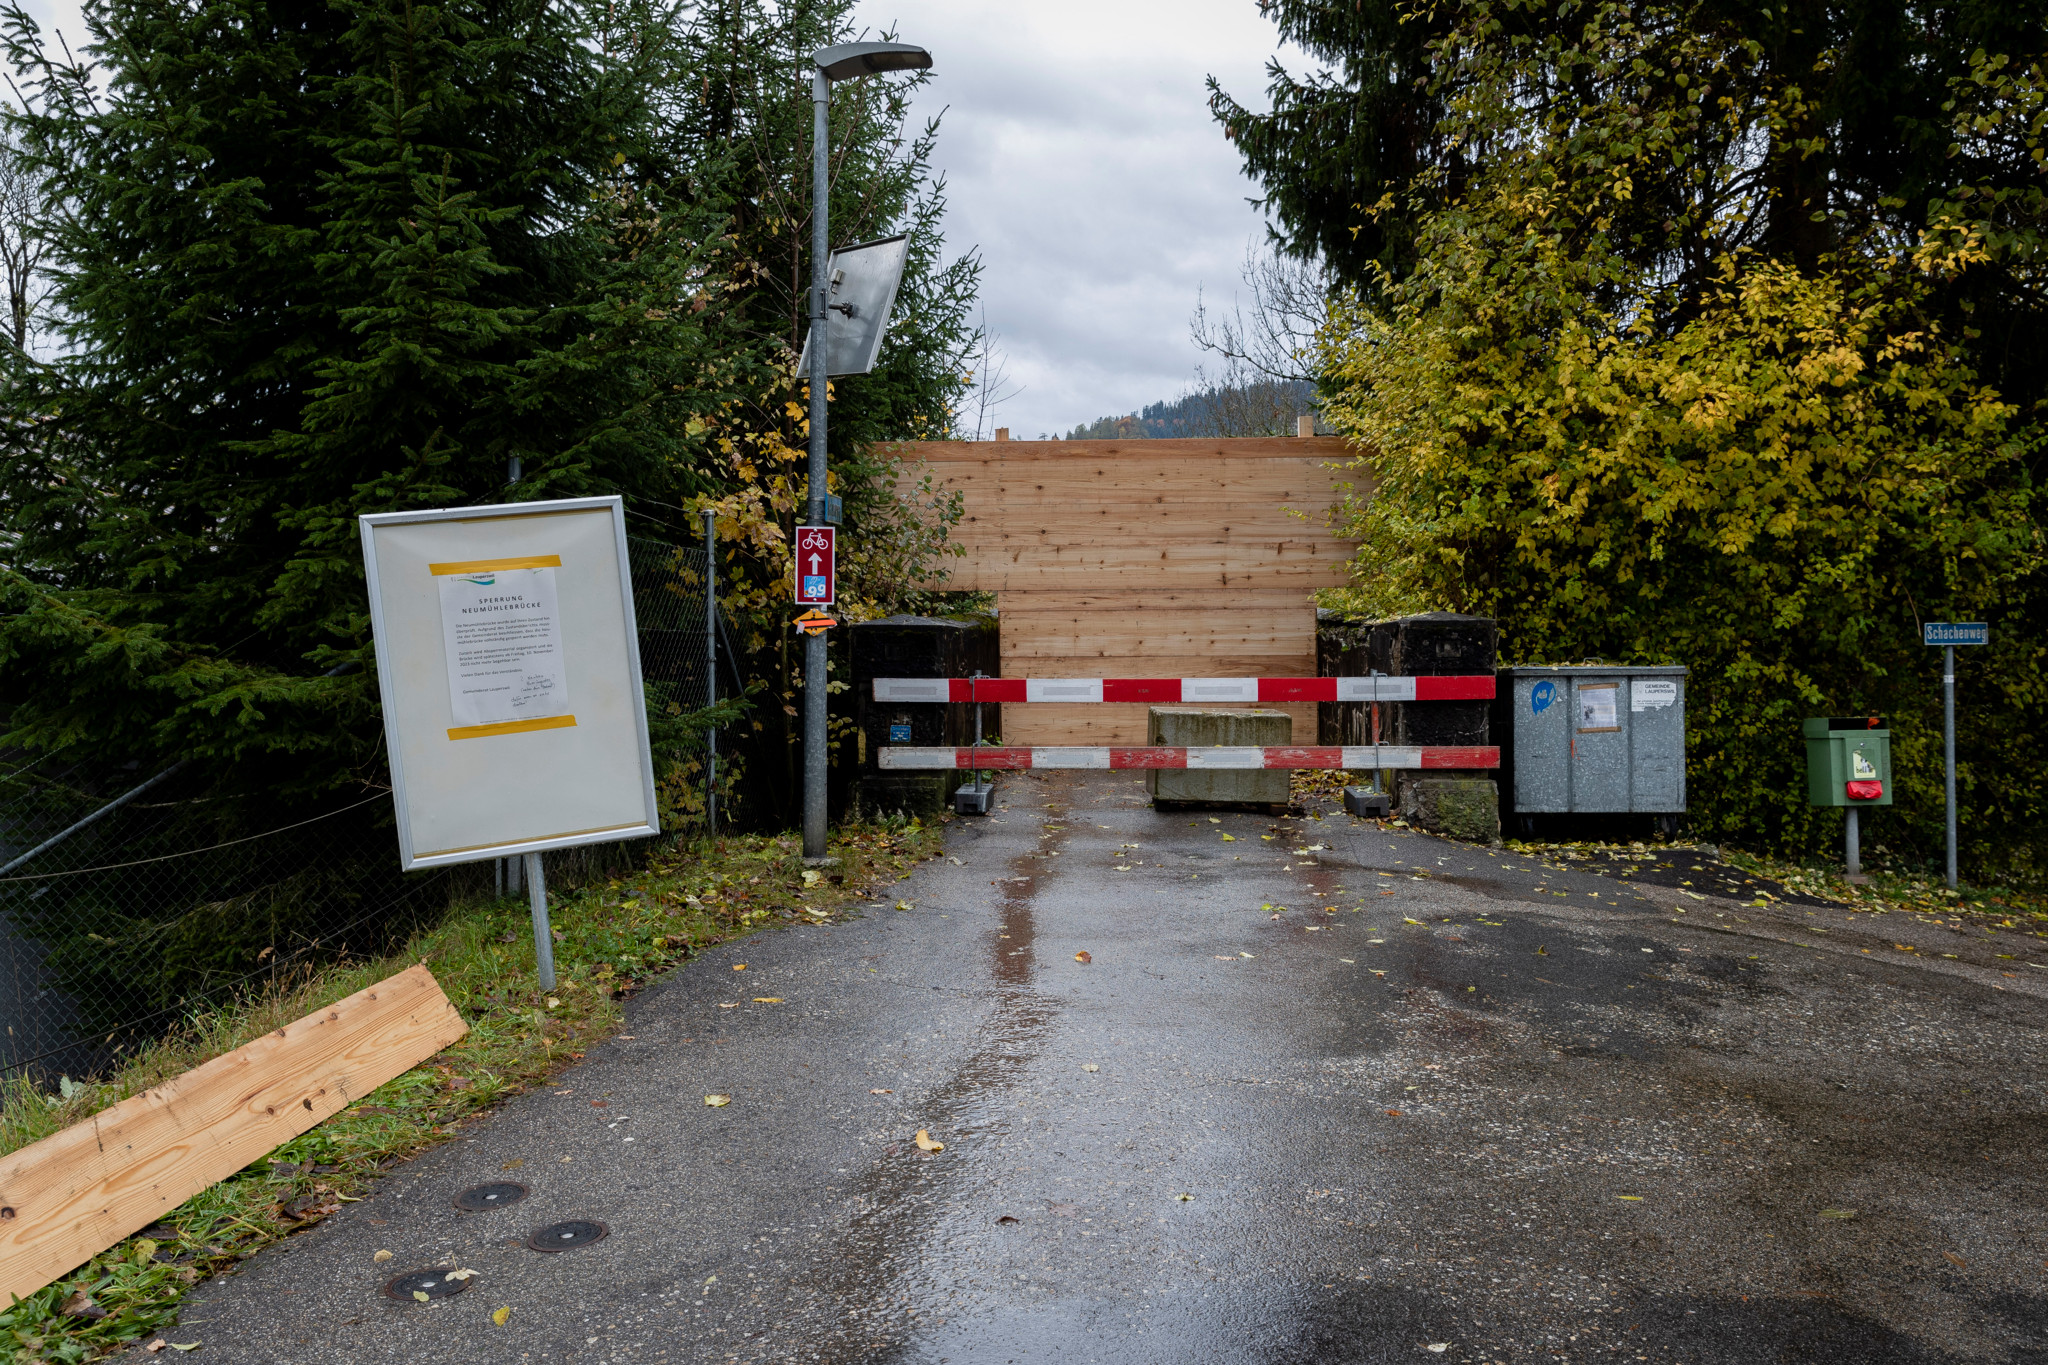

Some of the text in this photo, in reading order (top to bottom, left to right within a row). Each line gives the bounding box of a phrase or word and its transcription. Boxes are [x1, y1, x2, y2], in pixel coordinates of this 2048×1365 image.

[808, 584, 826, 597] 99
[479, 596, 523, 604] SPERRUNG
[462, 602, 541, 614] NEUMÜHLEBRÜCKE
[1927, 626, 1986, 642] Schachenweg
